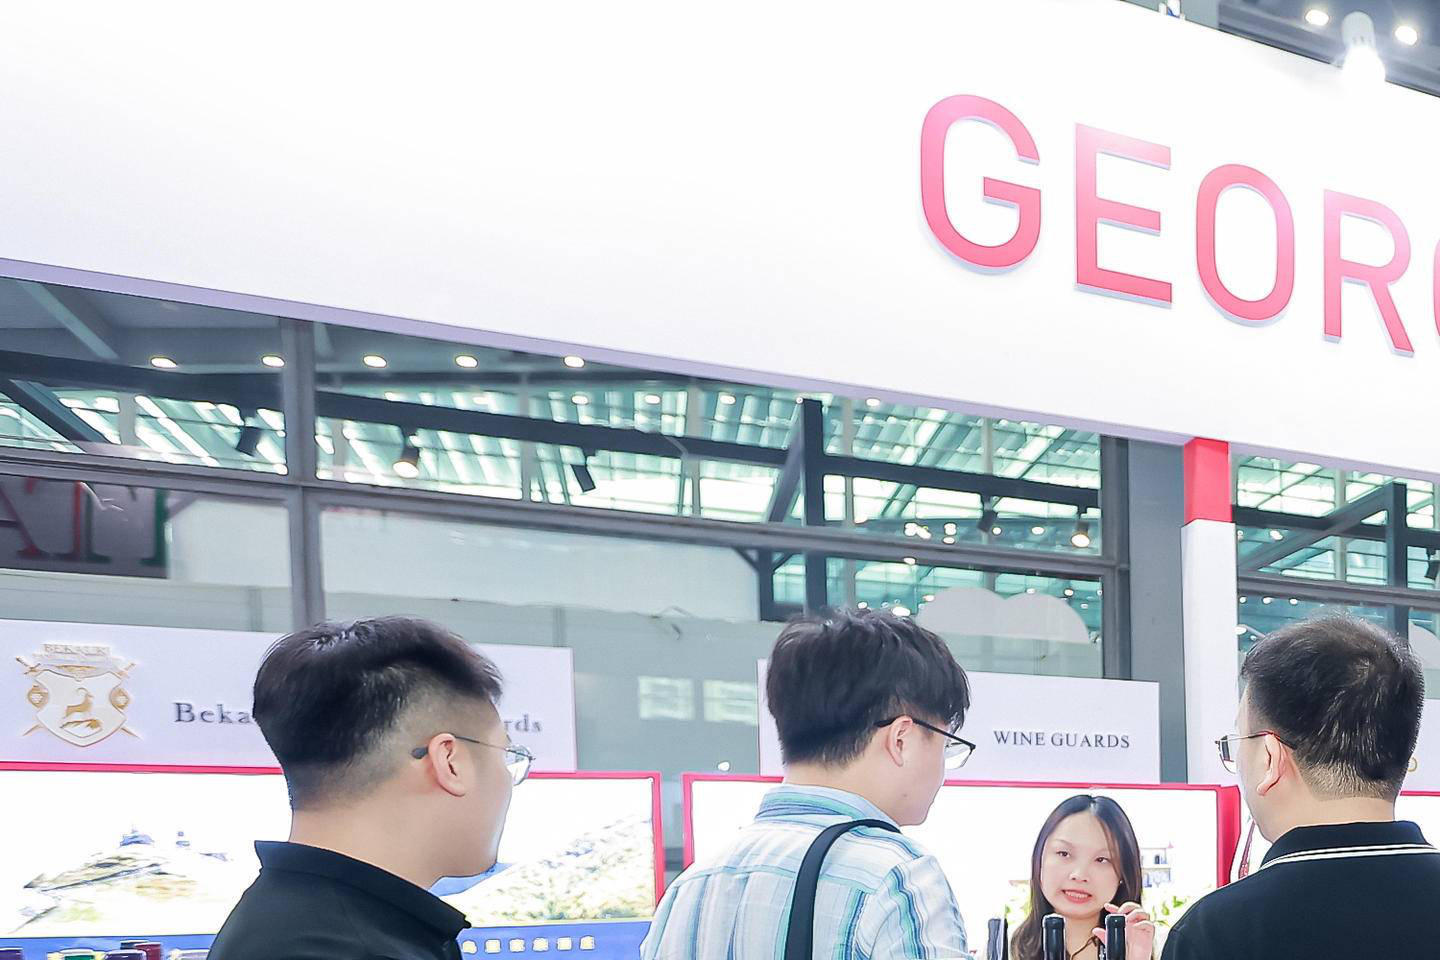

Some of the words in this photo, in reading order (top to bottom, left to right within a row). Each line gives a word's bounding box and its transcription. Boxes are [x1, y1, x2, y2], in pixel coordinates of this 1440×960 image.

[173, 702, 254, 724] Beka
[503, 713, 542, 732] rds
[993, 730, 1046, 746] WINE
[1051, 732, 1131, 749] GUARDS
